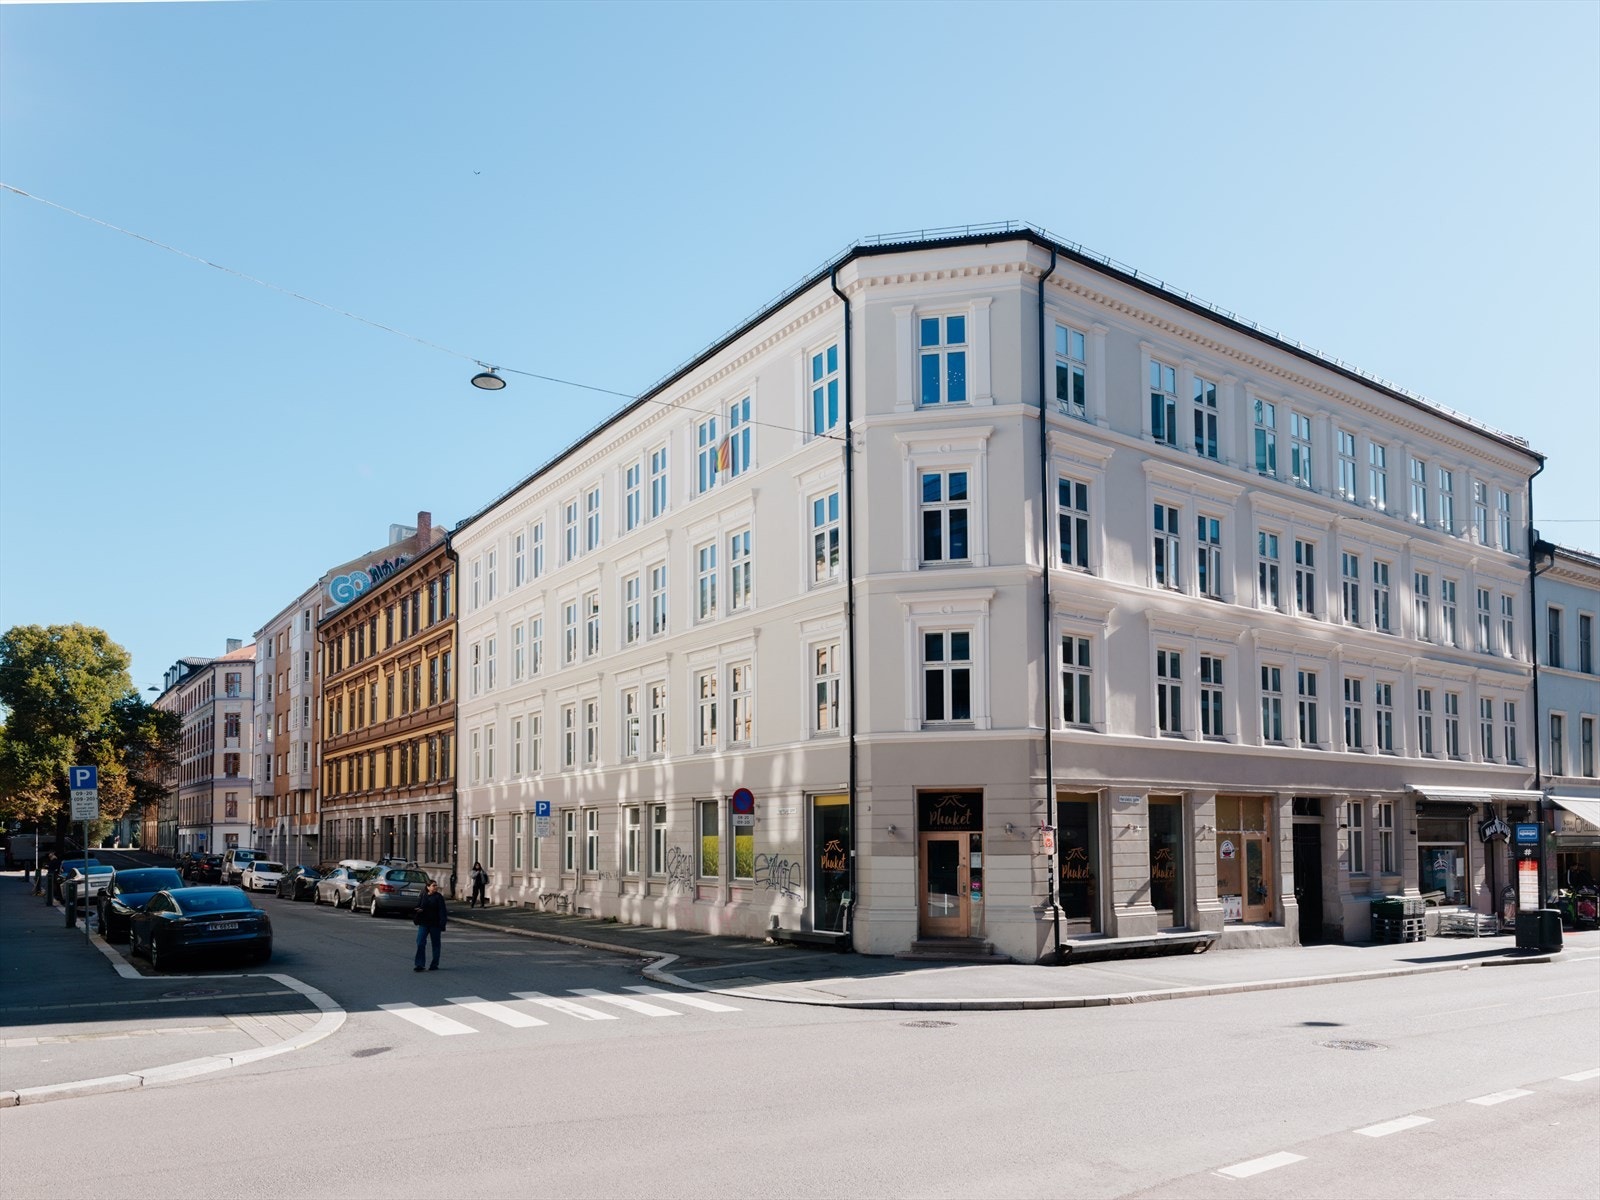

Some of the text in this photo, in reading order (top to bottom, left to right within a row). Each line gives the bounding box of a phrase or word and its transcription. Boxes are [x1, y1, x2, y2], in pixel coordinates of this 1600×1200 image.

[76, 769, 90, 787] P
[539, 802, 547, 815] P
[929, 807, 972, 825] Phuket
[821, 852, 848, 870] Phuket
[1061, 861, 1090, 879] Phuket
